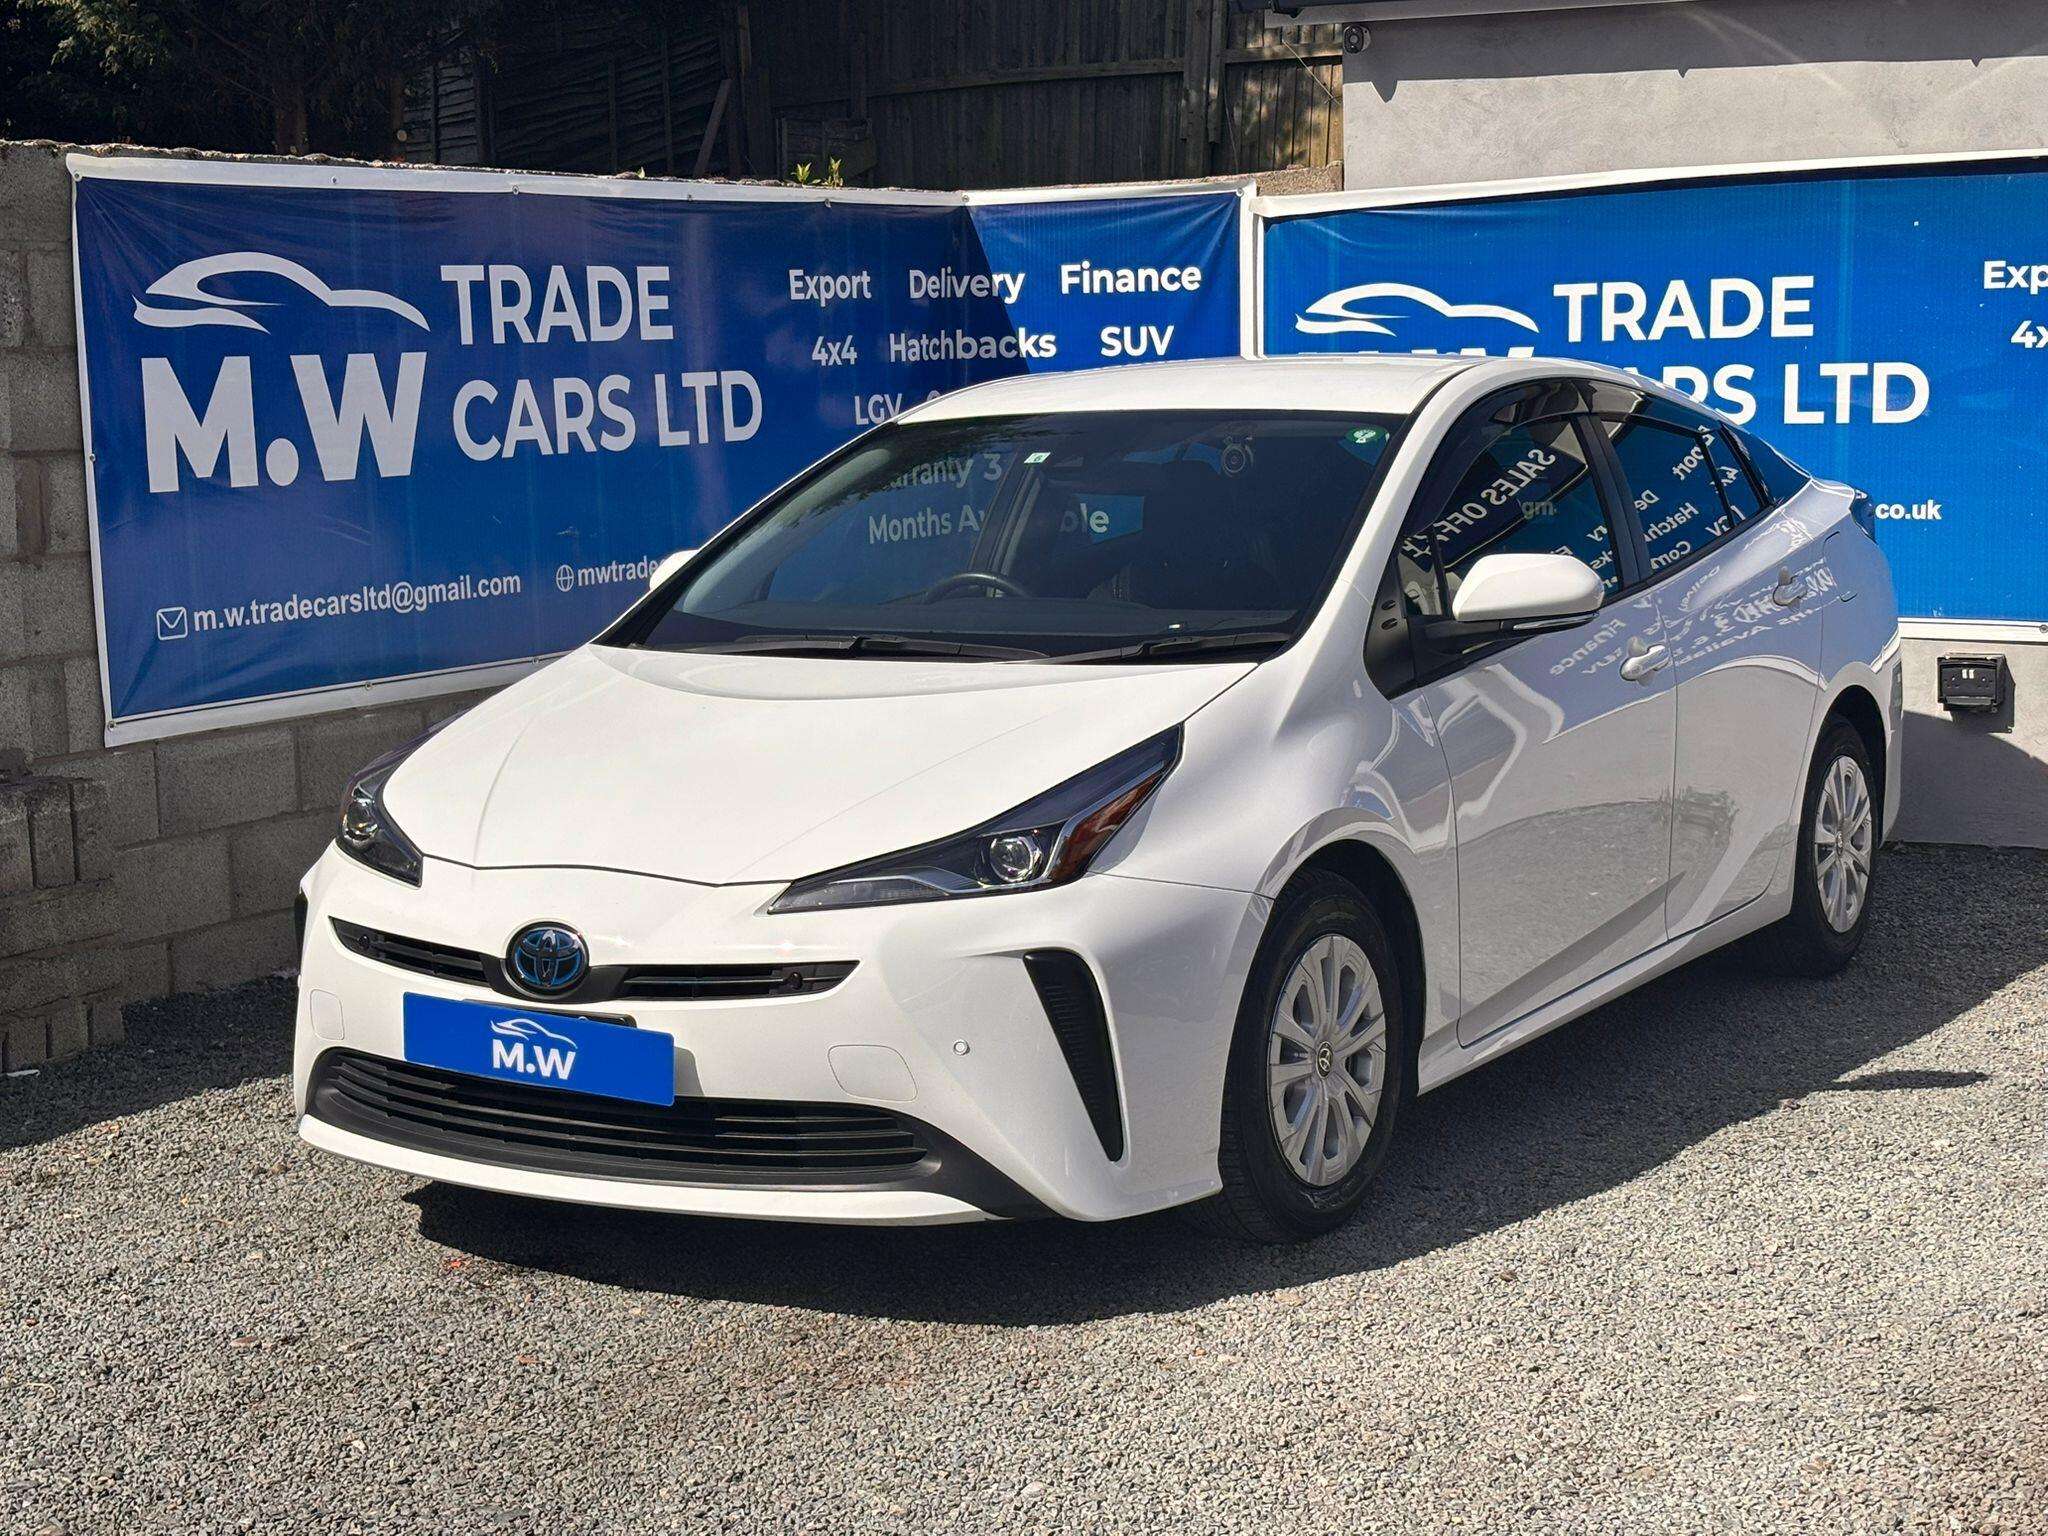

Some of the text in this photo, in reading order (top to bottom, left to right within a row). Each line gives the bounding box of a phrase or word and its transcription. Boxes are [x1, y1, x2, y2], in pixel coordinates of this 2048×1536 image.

[440, 264, 675, 346] TRADE
[788, 260, 1202, 307] Export Delivery Finance
[1553, 274, 1816, 344] TRADE
[811, 324, 1175, 367] 4x4 Hatchbacks SUV
[452, 369, 763, 461] CARS LTD
[854, 392, 903, 426] LGV
[1783, 361, 1931, 425] LTD
[140, 351, 428, 493] M.W
[868, 506, 952, 545] Months
[1874, 498, 1943, 521] co.uk
[577, 554, 662, 587] mwtrade
[193, 573, 522, 633] m.w.tradecarsltd@gmail.com
[491, 1038, 577, 1081] M.W
